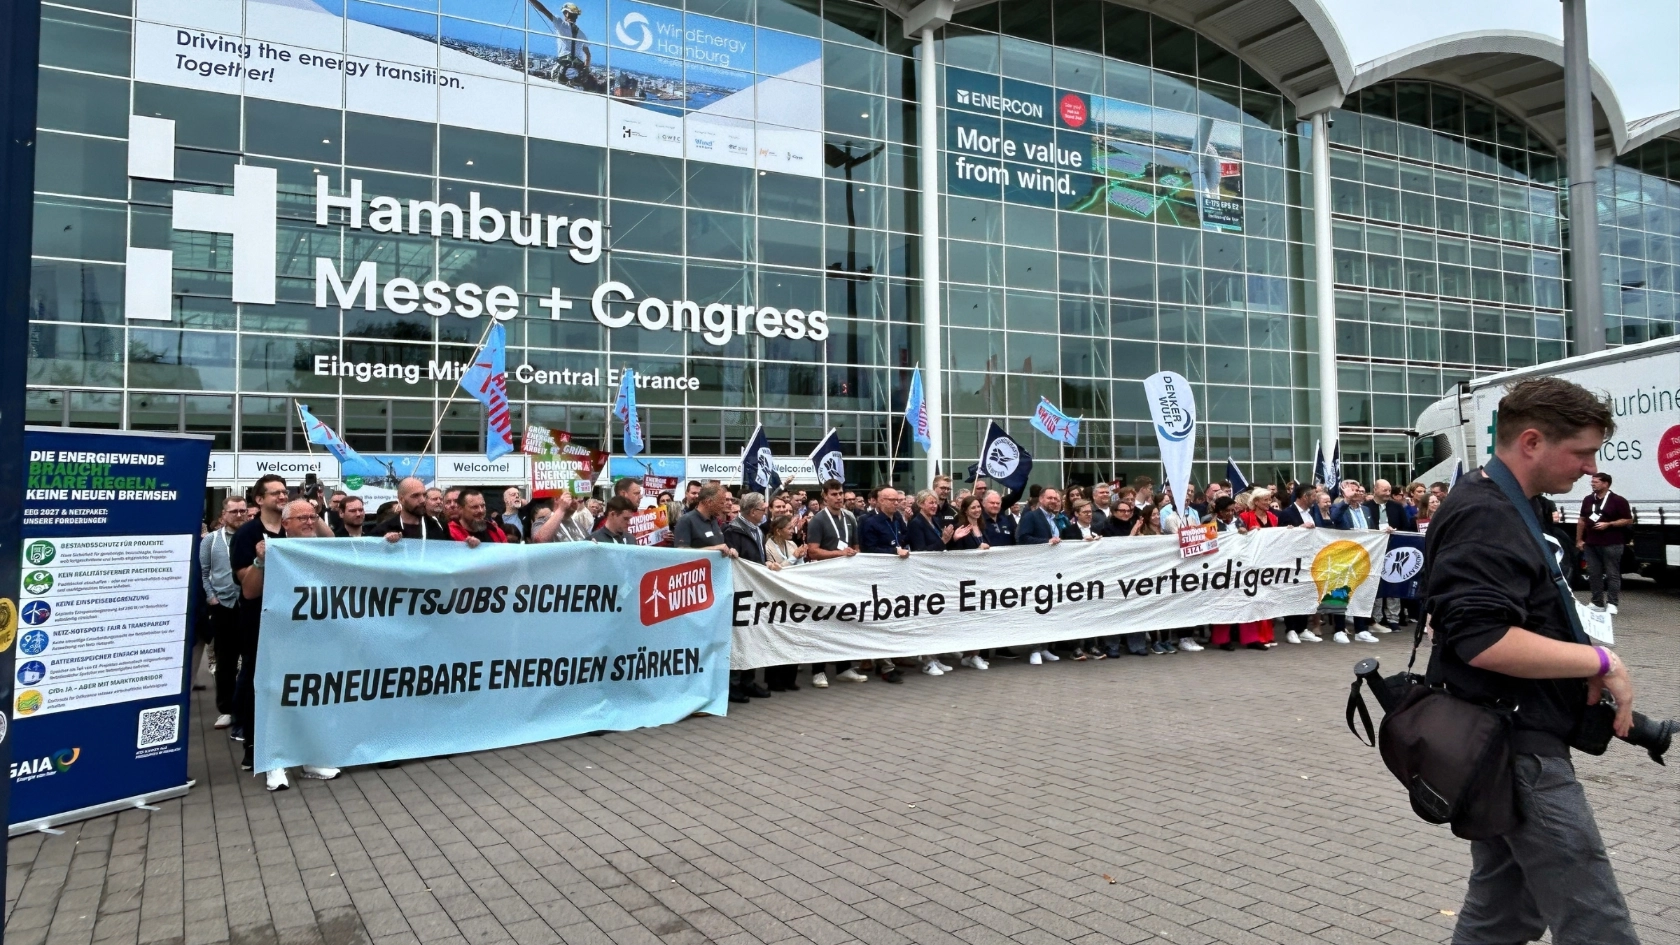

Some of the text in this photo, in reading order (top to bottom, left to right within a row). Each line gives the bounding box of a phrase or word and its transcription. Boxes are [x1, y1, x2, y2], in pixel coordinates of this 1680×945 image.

[657, 21, 747, 53] WindEnergy
[177, 30, 465, 89] Driving the energy transition.
[658, 40, 730, 66] Hamburg
[175, 54, 275, 83] Together!
[972, 92, 1043, 118] ENERCON
[957, 126, 1082, 167] More value
[956, 157, 1076, 195] from wind.
[316, 174, 602, 264] Hamburg
[315, 257, 828, 345] Messe + Congress
[314, 355, 420, 384] Eingang
[428, 360, 470, 381] Mit
[515, 364, 600, 387] Central
[1159, 396, 1174, 428] WULF
[1163, 376, 1182, 422] DENKER
[1613, 386, 1680, 417] urbine
[29, 450, 165, 465] DIE ENERGIEWENDE
[29, 462, 111, 476] BRAUCHT
[256, 462, 321, 472] Welcome!
[453, 462, 510, 472] Welcome!
[534, 460, 583, 472] JOBMOTOR
[700, 464, 742, 473] Welcome
[25, 489, 177, 501] KEINE NEUEN BREMSEN
[27, 475, 87, 488] KLARE
[92, 477, 156, 490] REGELN
[535, 479, 569, 490] WENDE
[23, 517, 53, 525] UNSERE
[668, 567, 706, 590] AKTION
[732, 558, 1301, 627] Erneuerbare Energien verteidigen!
[55, 599, 75, 607] KEINE
[291, 583, 622, 621] ZUKUNFTSJOBS SICHERN.
[668, 583, 708, 611] WIND
[280, 646, 704, 706] ERNEUERBARE ENERGIEN STÄRKEN.
